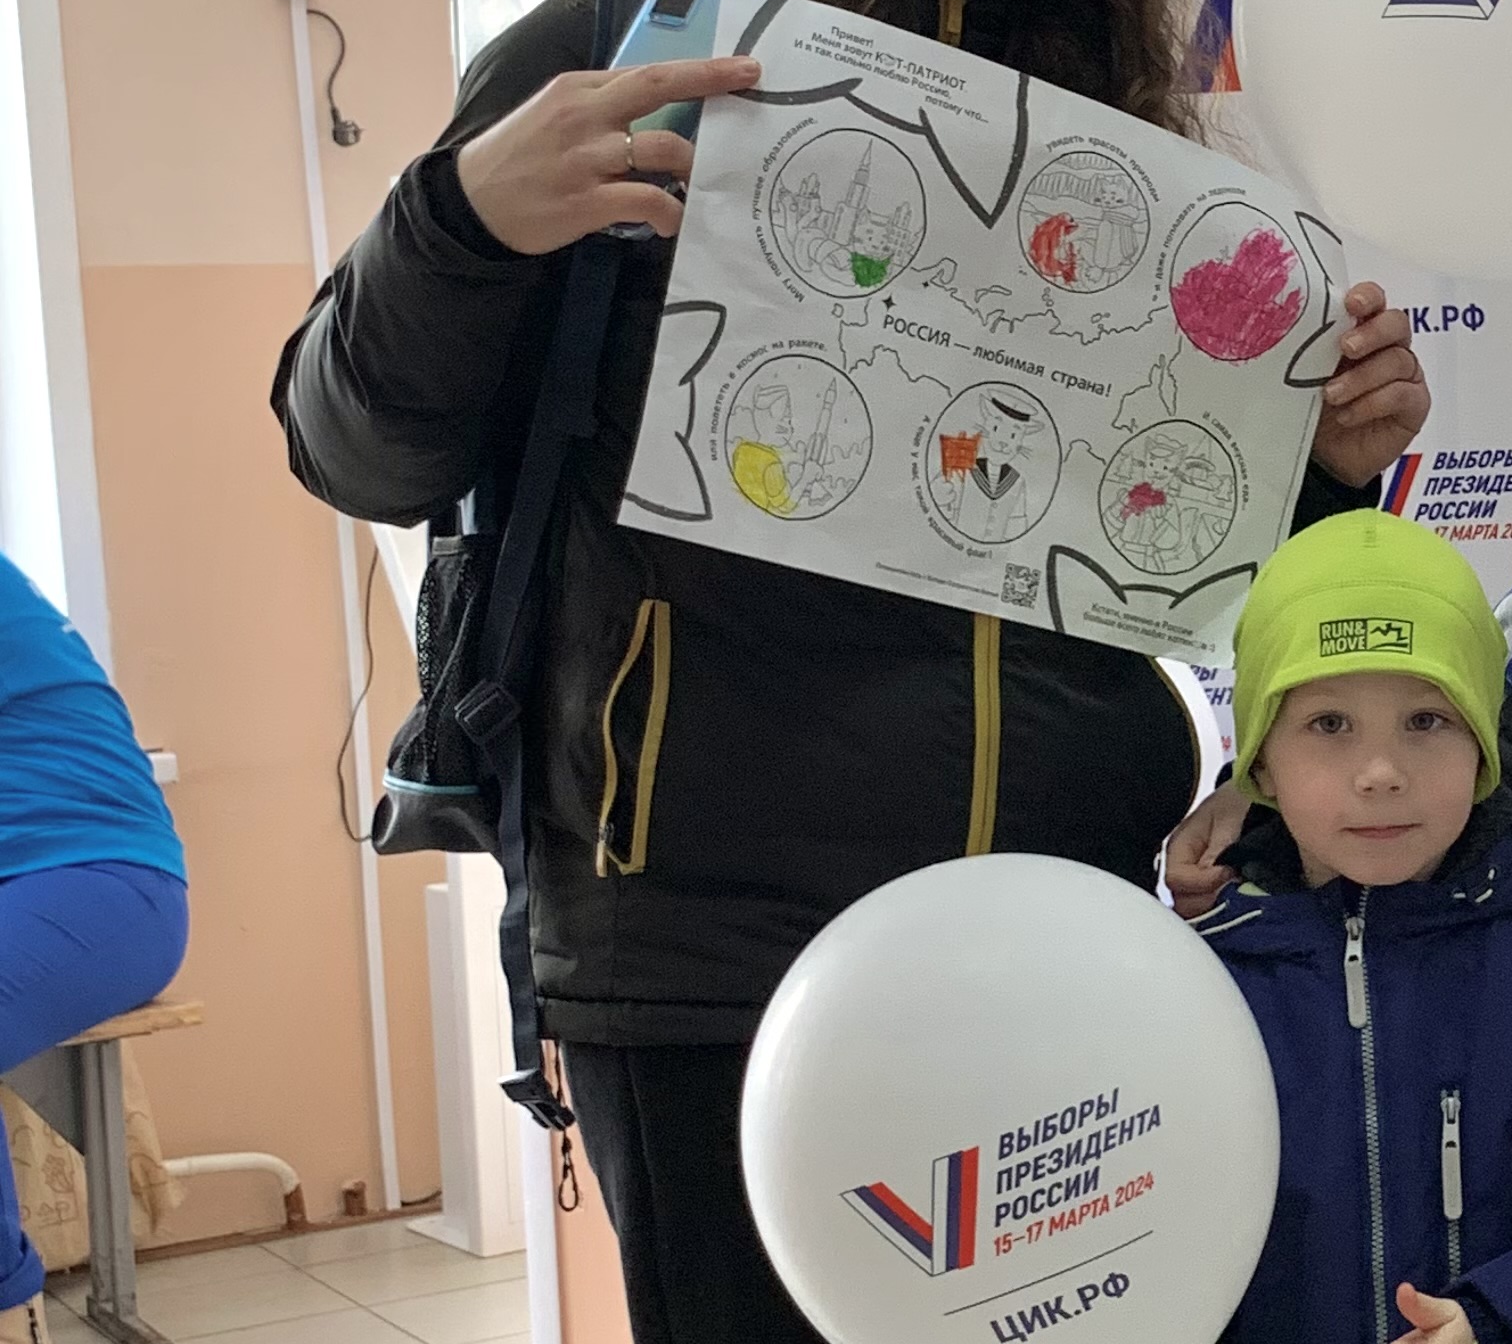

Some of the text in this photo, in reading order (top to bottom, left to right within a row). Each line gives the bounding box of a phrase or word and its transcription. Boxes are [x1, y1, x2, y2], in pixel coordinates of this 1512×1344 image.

[811, 32, 841, 50] Меня
[831, 25, 874, 49] Привет!
[883, 313, 1112, 398] РОССИЯ любимая страна!
[1414, 499, 1498, 522] РОССИИ
[1449, 523, 1500, 542] МАРТА
[1321, 620, 1366, 639] RUN&
[1321, 636, 1366, 655] MOVE
[997, 1087, 1120, 1161] ВЫБОРЫ
[996, 1104, 1161, 1195] ПРЕЗИДЕНТА
[994, 1165, 1100, 1228] РОССИИ
[1048, 1194, 1111, 1237] МАРТА
[1114, 1171, 1155, 1208] 2024
[990, 1271, 1131, 1344] ЦИК.РФ
